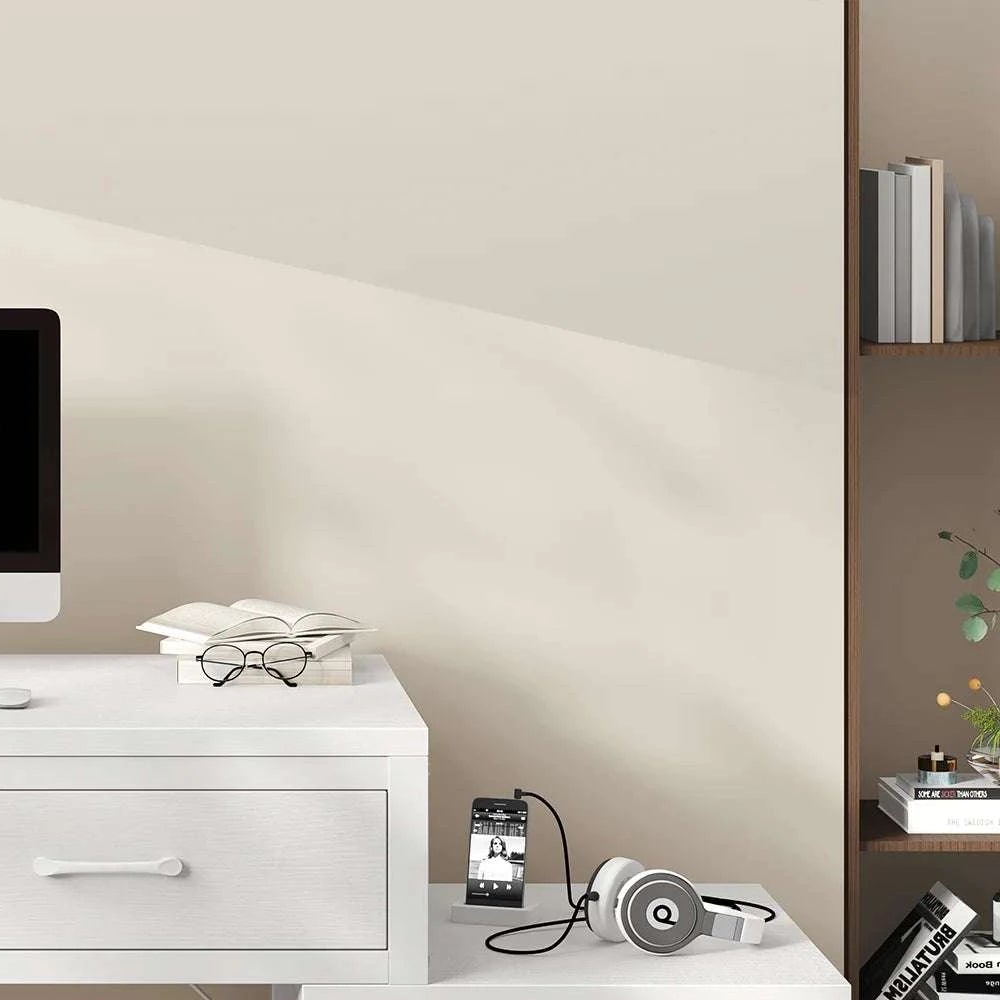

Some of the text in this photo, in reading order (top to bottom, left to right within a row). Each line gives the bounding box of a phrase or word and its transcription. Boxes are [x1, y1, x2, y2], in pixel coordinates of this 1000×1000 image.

[918, 790, 931, 798] SOME
[931, 790, 941, 798] ARE
[957, 790, 969, 798] THAN
[969, 790, 988, 798] OTHERS
